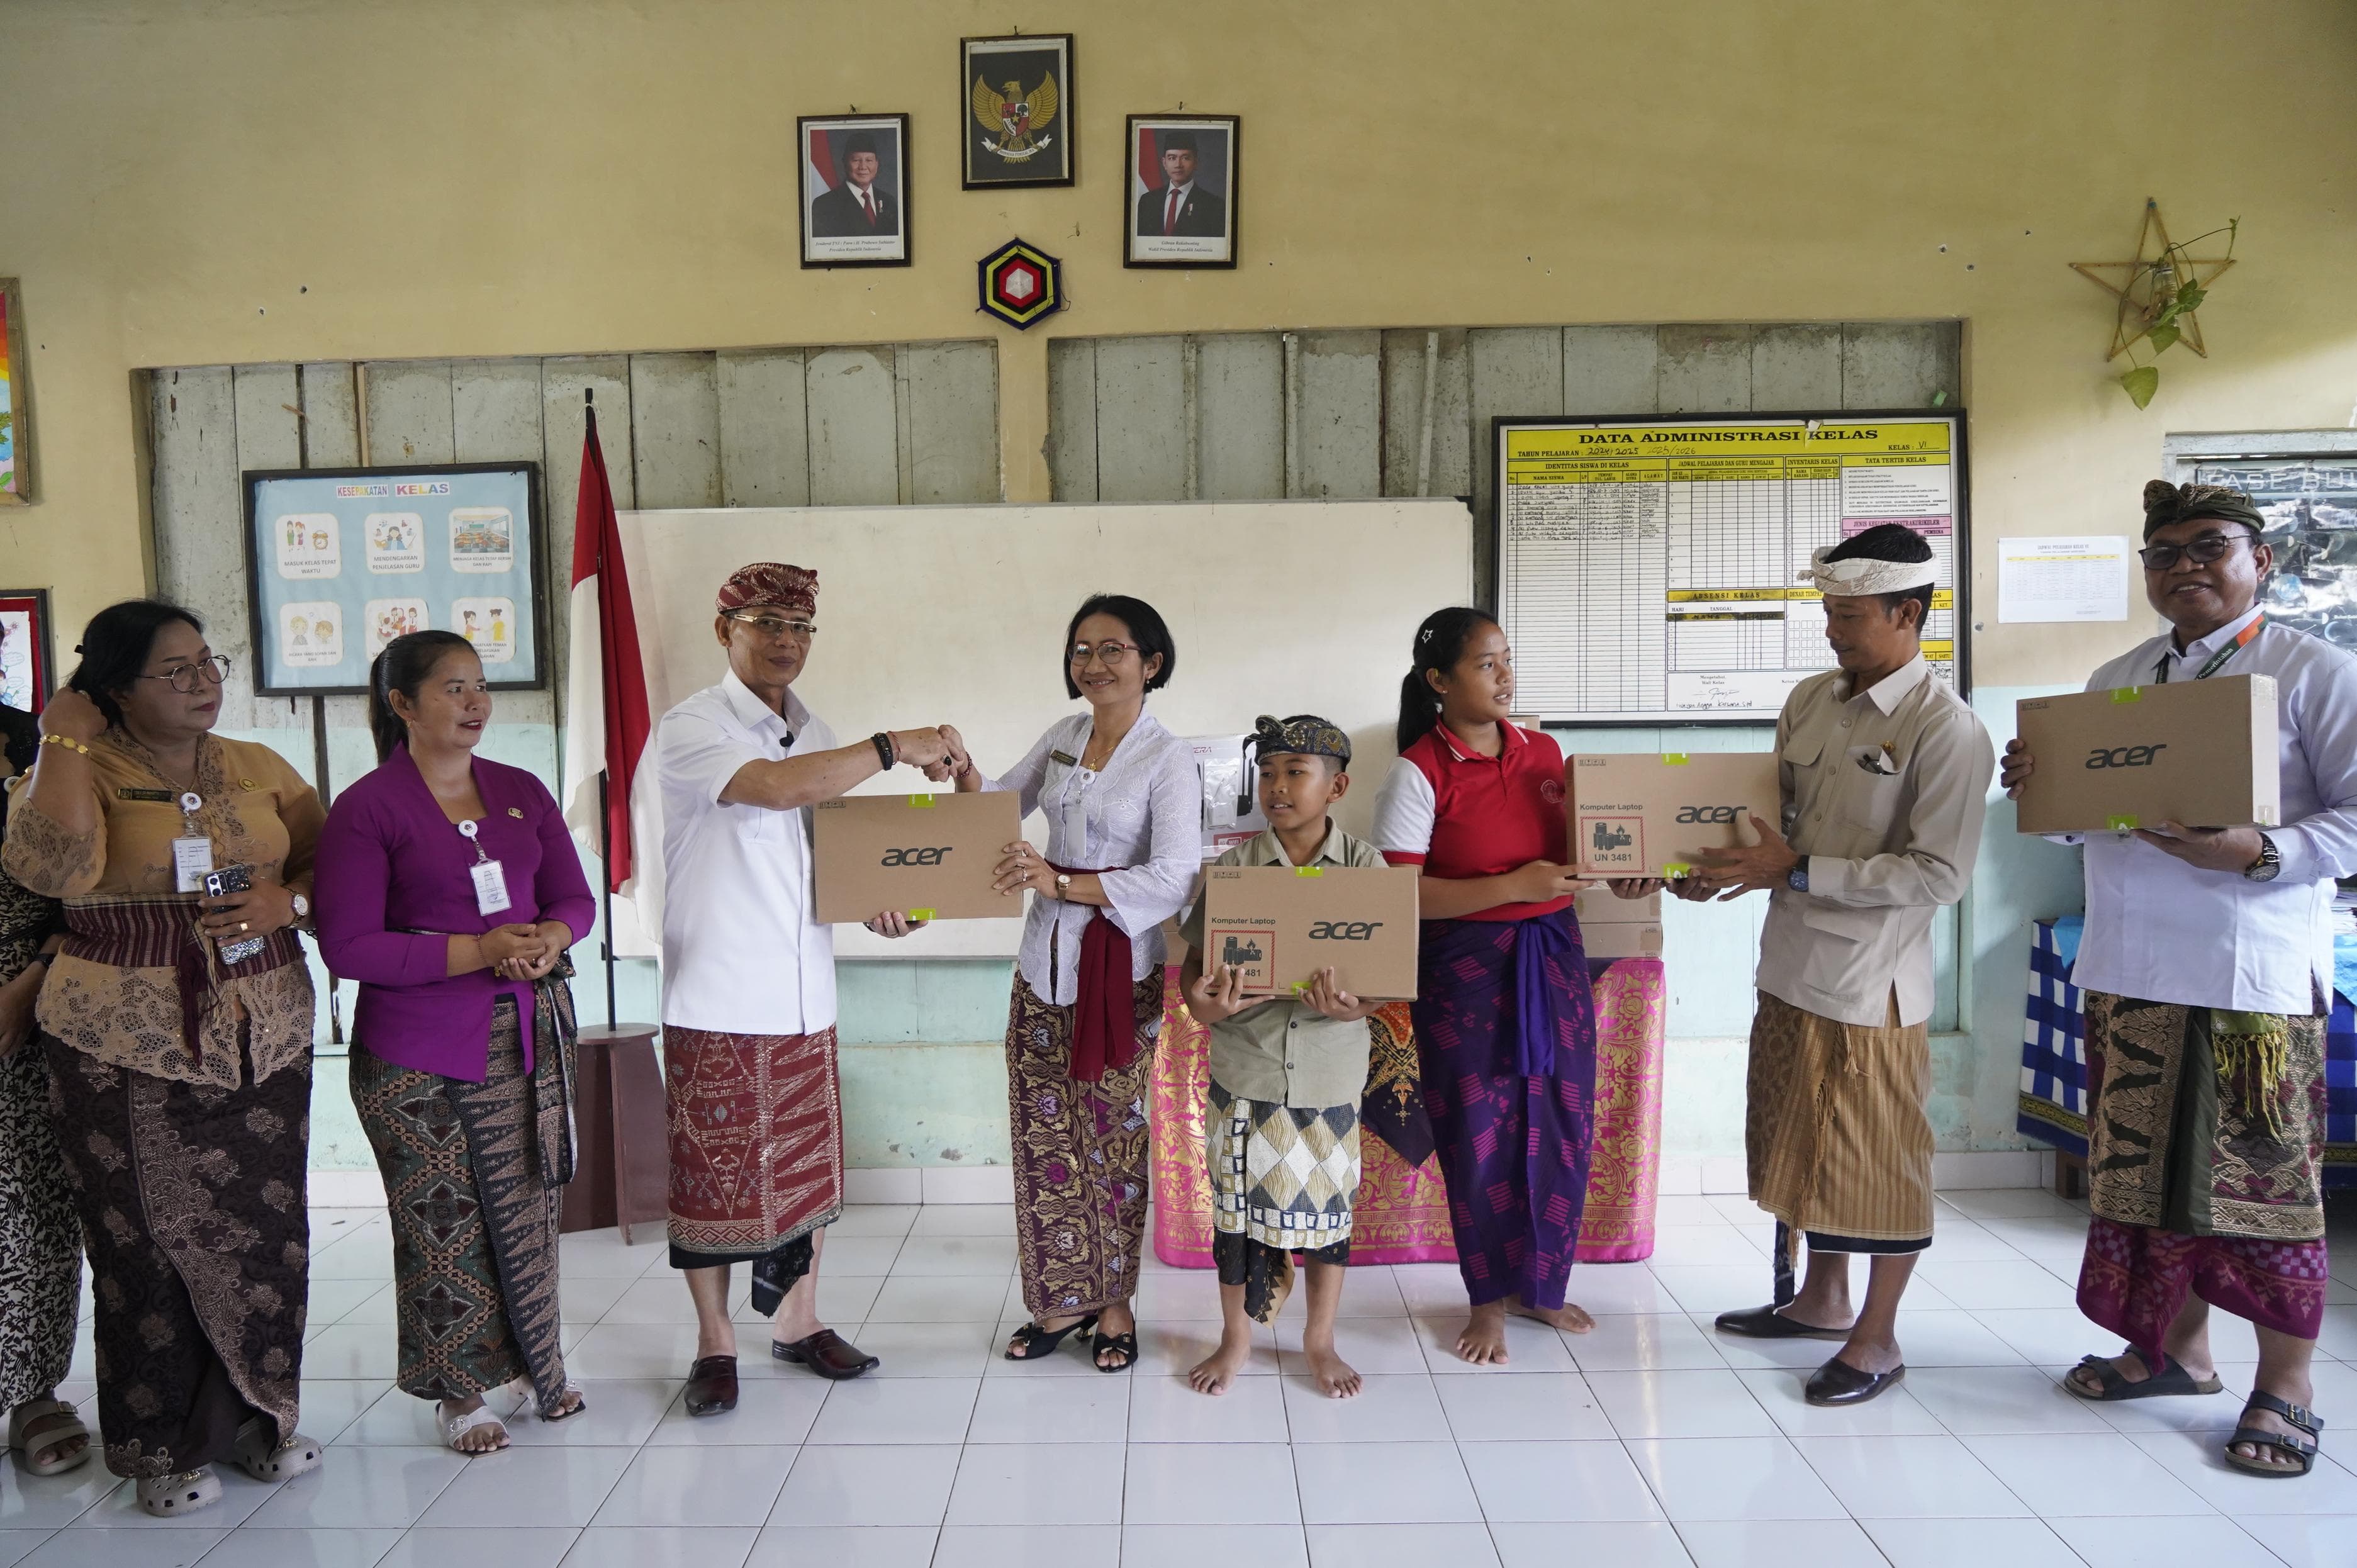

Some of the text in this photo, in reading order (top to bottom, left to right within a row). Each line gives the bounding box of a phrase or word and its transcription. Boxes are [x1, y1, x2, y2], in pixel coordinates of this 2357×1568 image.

[1579, 430, 1878, 444] DATA ADMINISTRASI KELAS
[337, 483, 449, 496] KESEPAKATAN KELAS
[2198, 647, 2234, 679] Pemerintahan
[2085, 743, 2167, 770] acer
[1675, 806, 1747, 824] acer
[881, 847, 953, 866] acer
[1611, 853, 1632, 861] 3481
[1211, 917, 1276, 926] Komputer Laptop
[1308, 921, 1384, 941] acer
